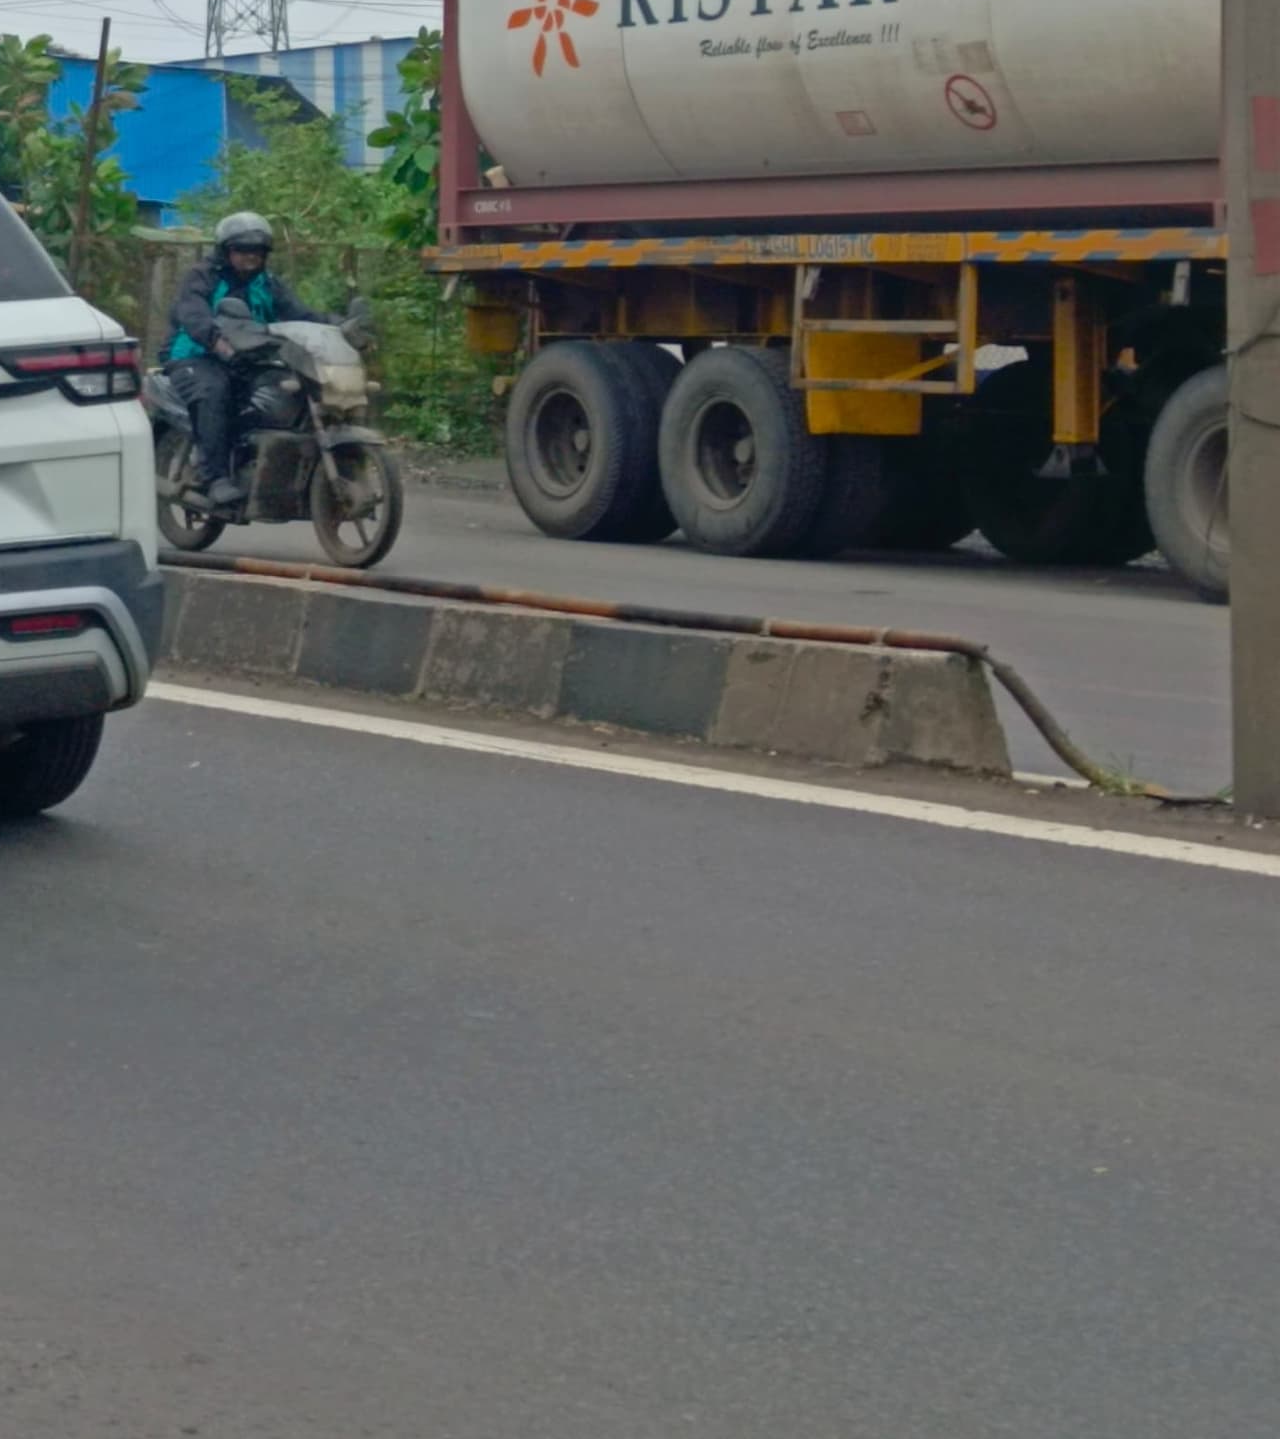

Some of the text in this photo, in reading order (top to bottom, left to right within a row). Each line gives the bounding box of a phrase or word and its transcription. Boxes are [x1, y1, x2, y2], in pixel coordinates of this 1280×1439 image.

[699, 39, 752, 57] Reliable
[755, 36, 784, 60] flow
[790, 32, 803, 55] of
[807, 29, 873, 50] Excellence
